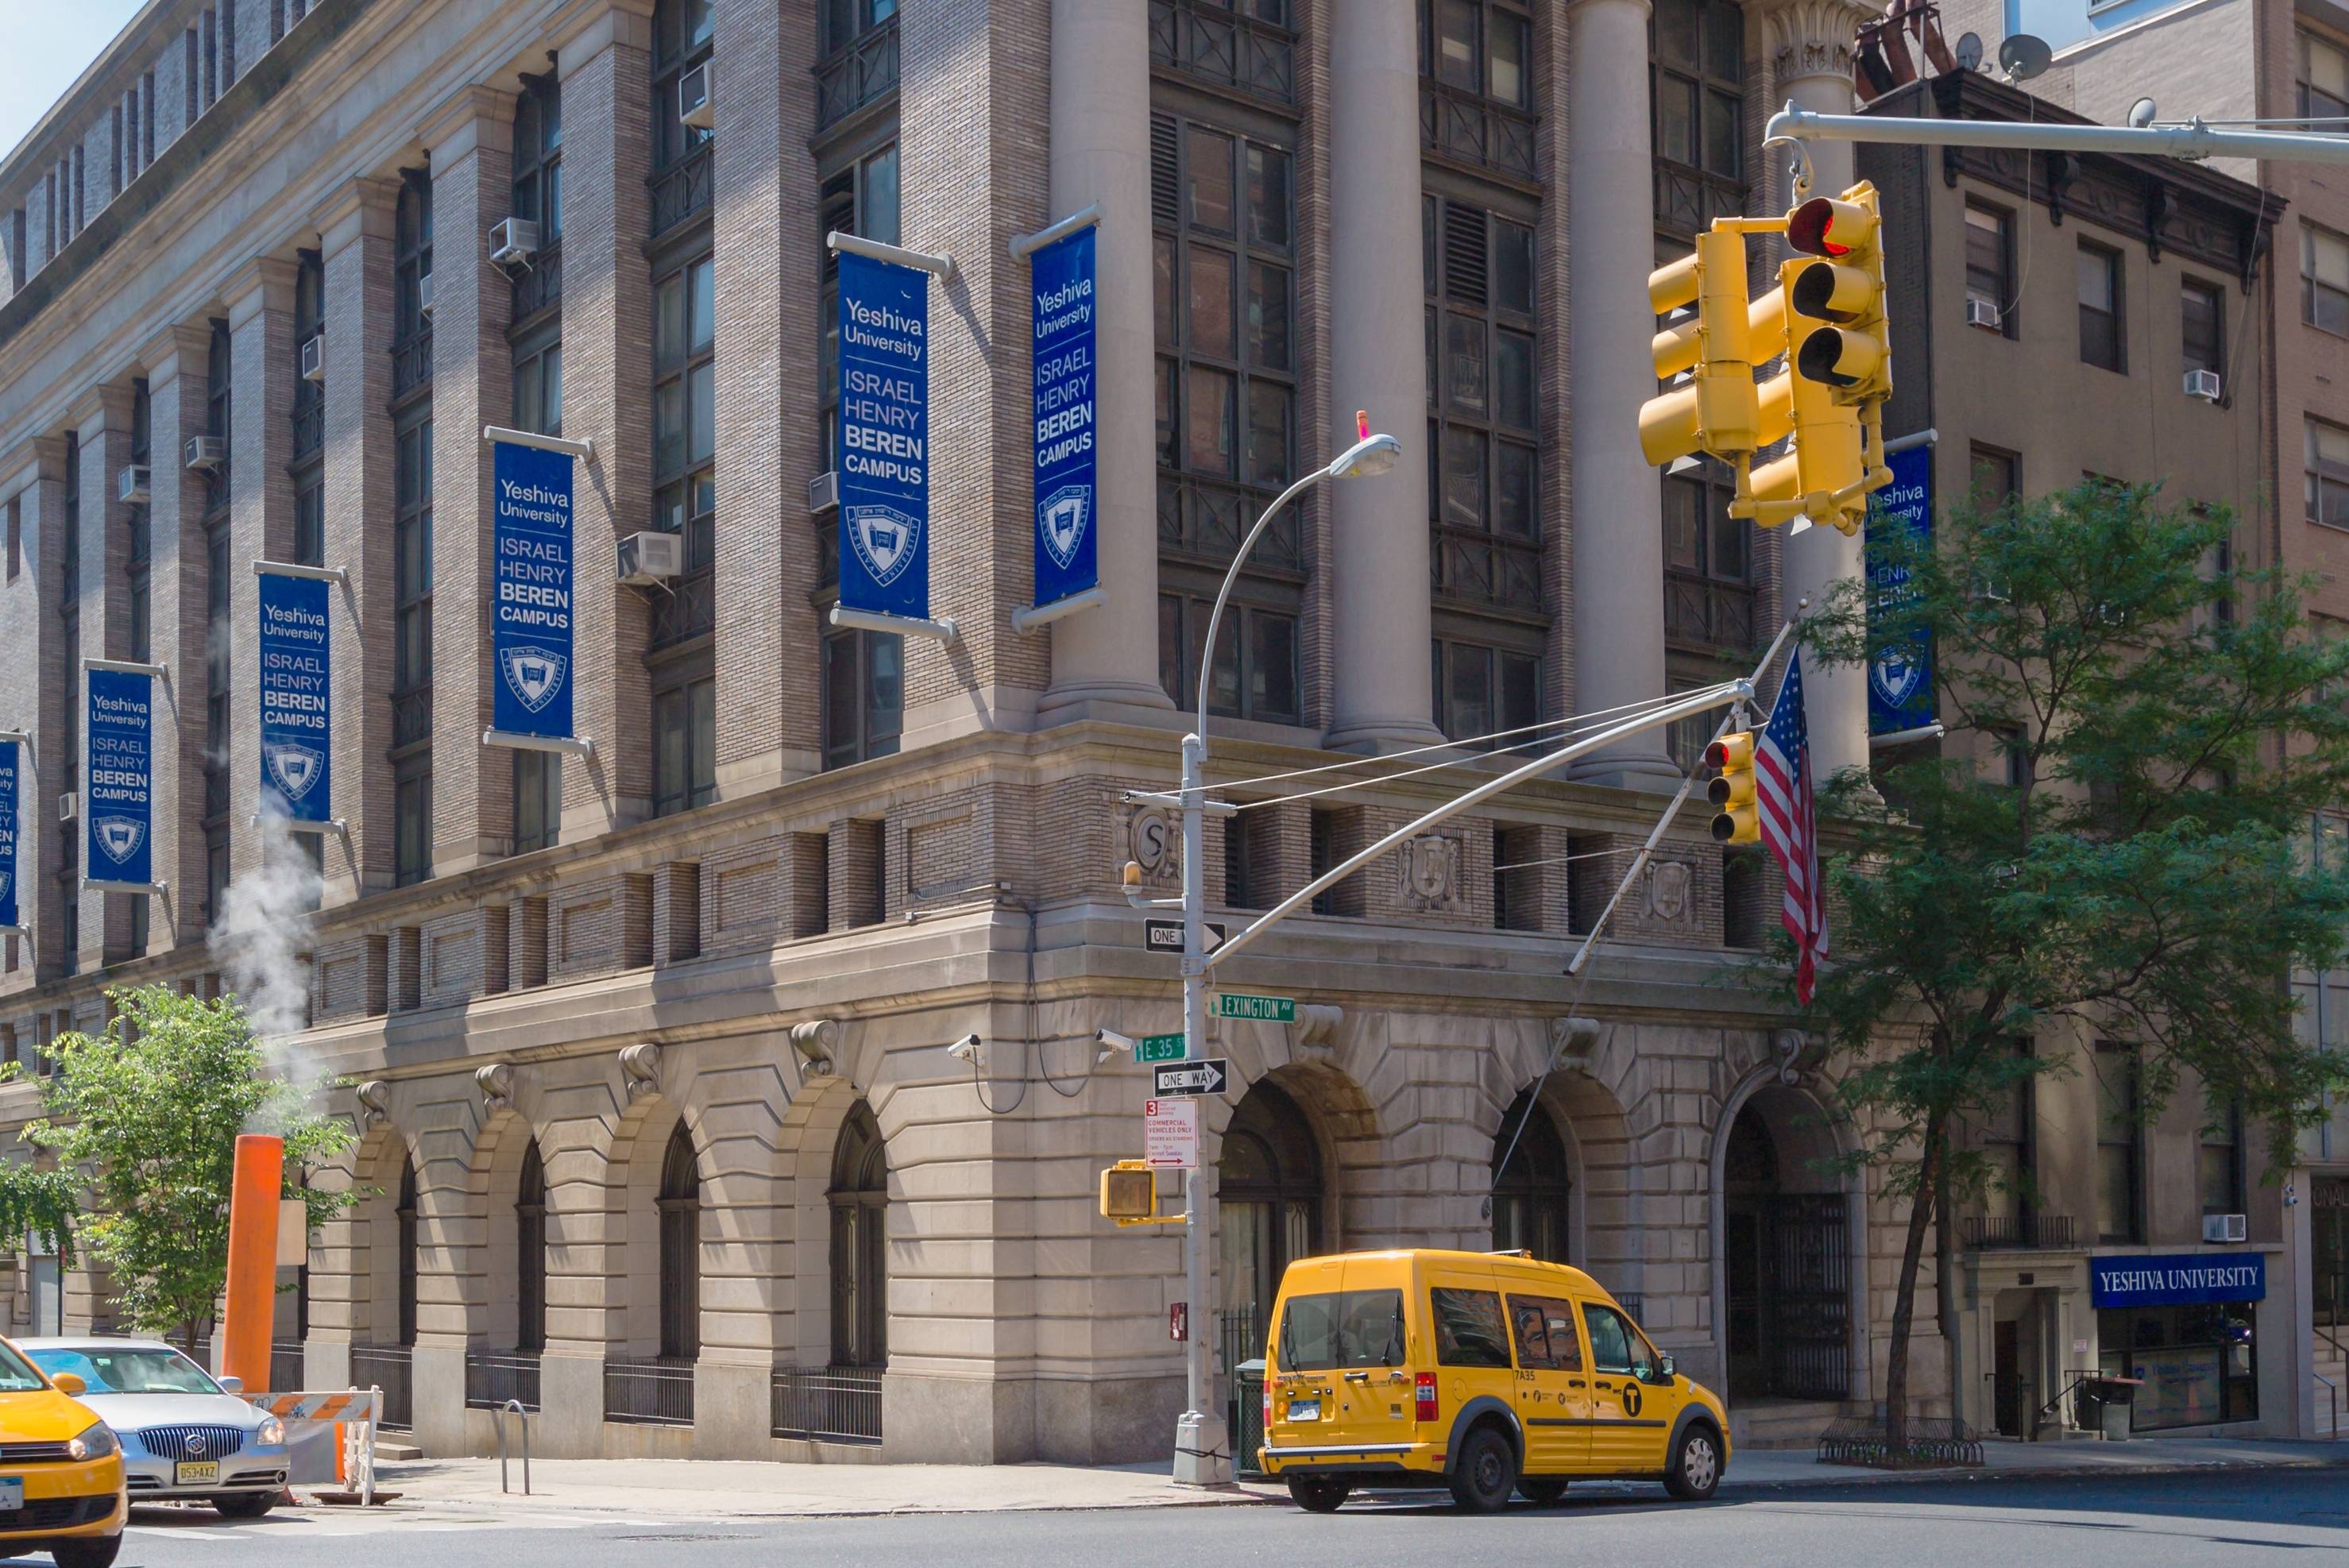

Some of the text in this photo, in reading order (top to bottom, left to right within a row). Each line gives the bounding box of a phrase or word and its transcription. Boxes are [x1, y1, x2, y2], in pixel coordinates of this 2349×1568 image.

[1037, 280, 1091, 315] Yeshiva
[845, 298, 922, 336] Yeshiva
[1037, 303, 1091, 338] University
[845, 323, 922, 361] University
[1037, 347, 1091, 387] ISRAEL
[846, 369, 921, 404] ISRAEL
[1037, 372, 1091, 415] HENRY
[845, 397, 919, 430] HENRY
[1037, 399, 1091, 442] BEREN
[846, 424, 921, 460] BEREN
[1038, 430, 1091, 467] CAMPUS
[846, 454, 921, 484] CAMPUS
[501, 479, 568, 507] Yeshiva
[500, 501, 567, 528] University
[501, 537, 567, 563] ISRAEL
[500, 560, 566, 584] HENRY
[500, 582, 568, 608] BEREN
[265, 604, 325, 626] Yeshiva
[500, 606, 568, 628] CAMPUS
[265, 623, 324, 643] University
[265, 653, 324, 673] ISRAEL
[265, 672, 323, 691] HENRY
[94, 695, 147, 713] Yeshiva
[265, 691, 325, 712] BEREN
[93, 711, 146, 728] University
[265, 711, 325, 728] CAMPUS
[93, 737, 146, 754] ISRAEL
[93, 754, 145, 769] HENRY
[93, 770, 147, 787] BEREN
[93, 787, 147, 801] CAMPUS
[1153, 929, 1176, 943] ONE
[1220, 995, 1292, 1018] LEXINGTON AV
[1146, 1041, 1153, 1059] E
[1158, 1038, 1173, 1056] 35
[1164, 1071, 1215, 1087] ONE WAY
[1148, 1102, 1157, 1115] 3
[2100, 1267, 2258, 1292] YESHIVA UNIVERSITY
[1515, 1370, 1536, 1381] 7A35
